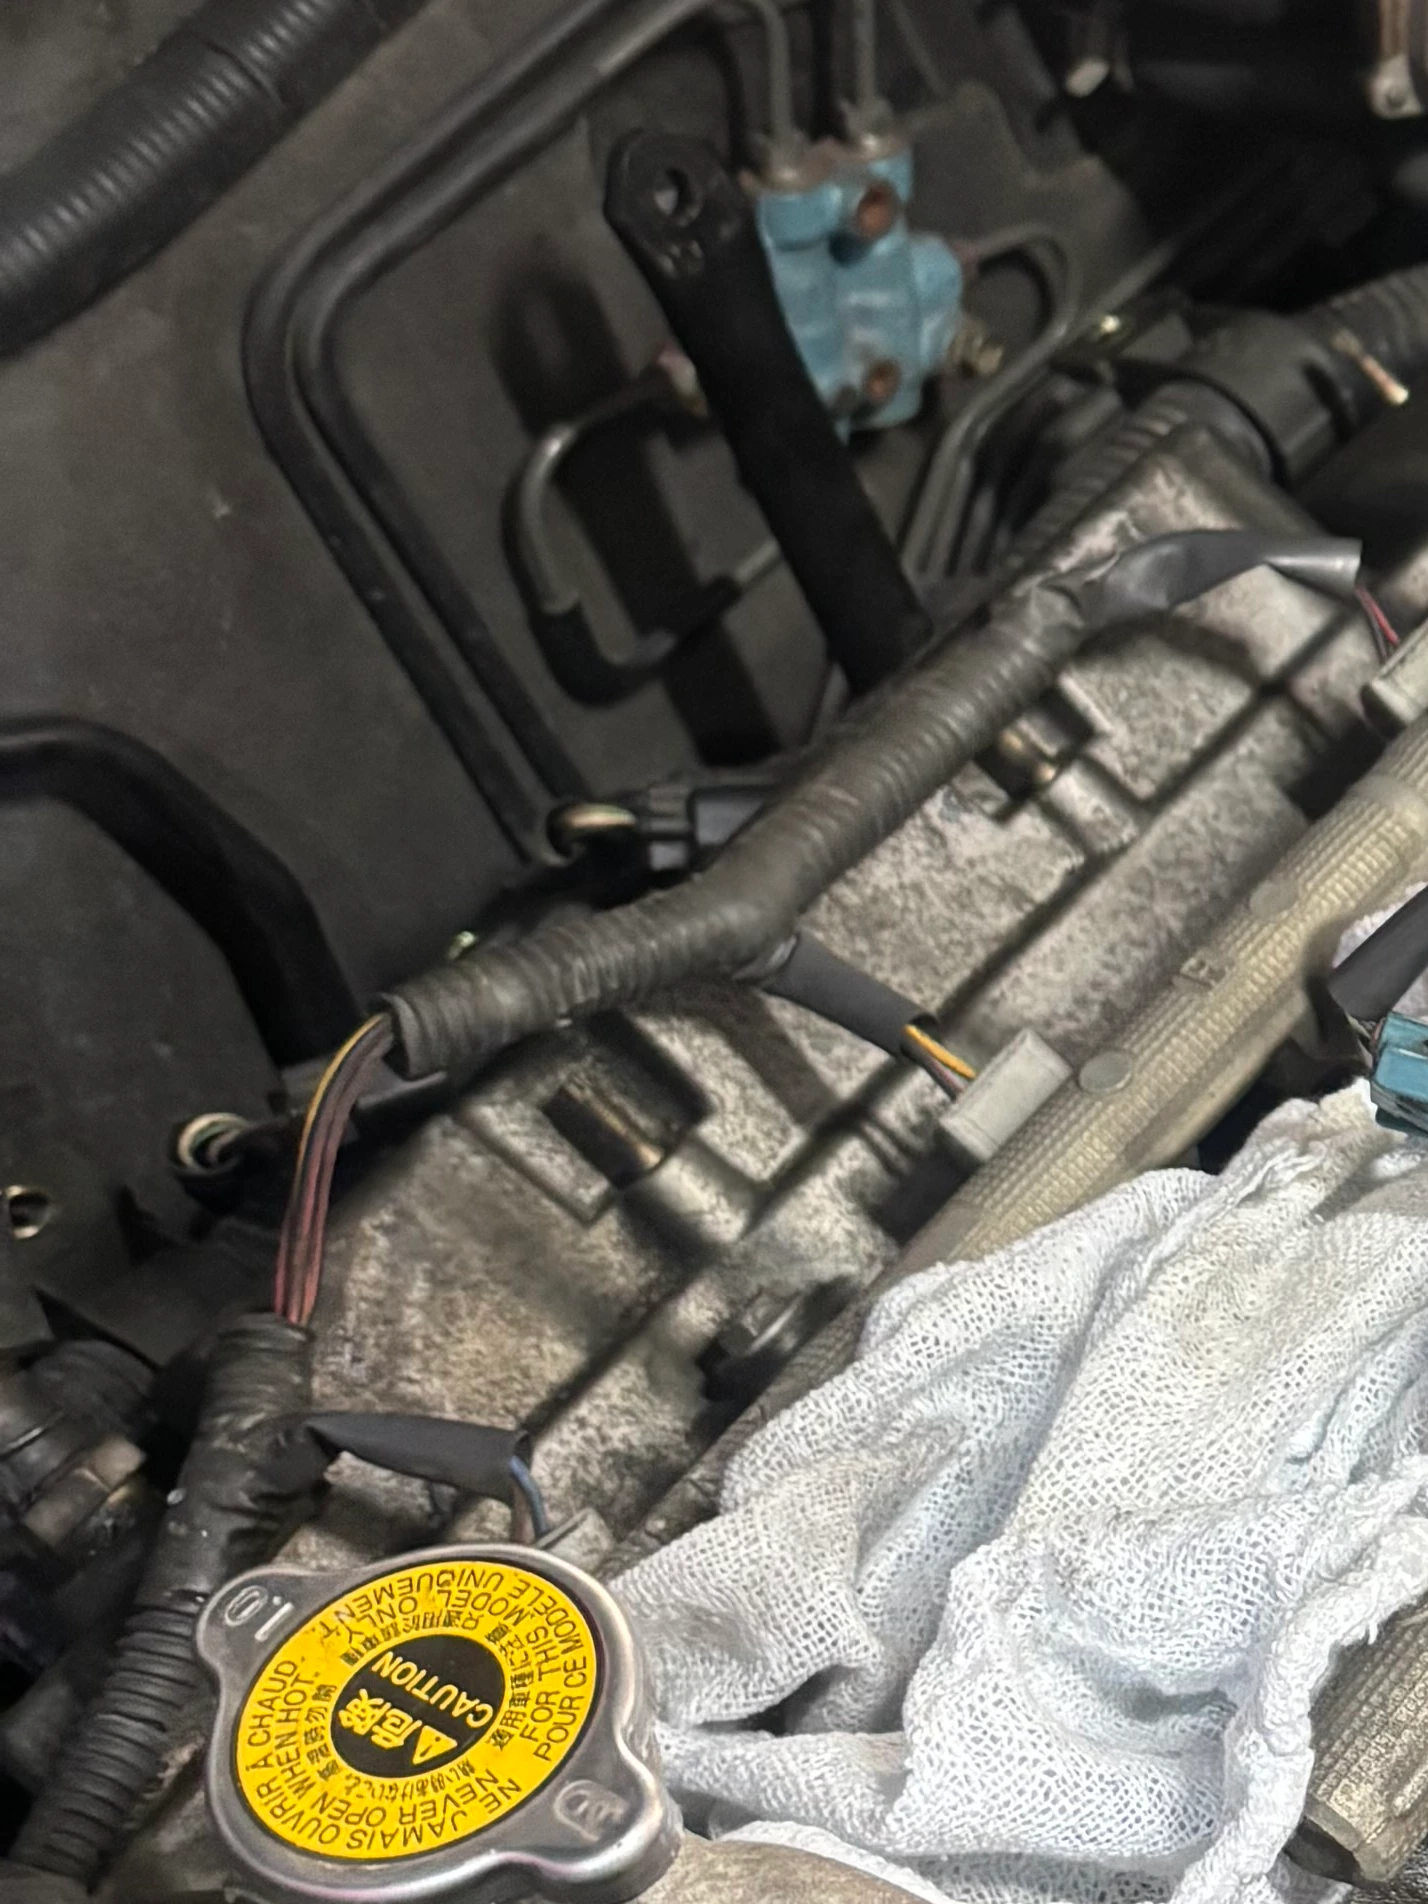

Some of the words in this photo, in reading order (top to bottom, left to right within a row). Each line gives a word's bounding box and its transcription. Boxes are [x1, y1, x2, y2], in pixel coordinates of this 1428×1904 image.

[437, 1589, 531, 1627] MODEL
[526, 1625, 562, 1682] THIS
[371, 1651, 494, 1728] CAUTION
[520, 1689, 561, 1742] FOR
[533, 1694, 584, 1762] POUR
[563, 1655, 588, 1689] CE
[275, 1730, 316, 1800] WHEN
[256, 1776, 340, 1845] OUVRIR
[311, 1791, 387, 1828] OPEN
[399, 1769, 499, 1826] NEVER
[479, 1778, 522, 1814] NE
[346, 1809, 467, 1851] JAMAIS
